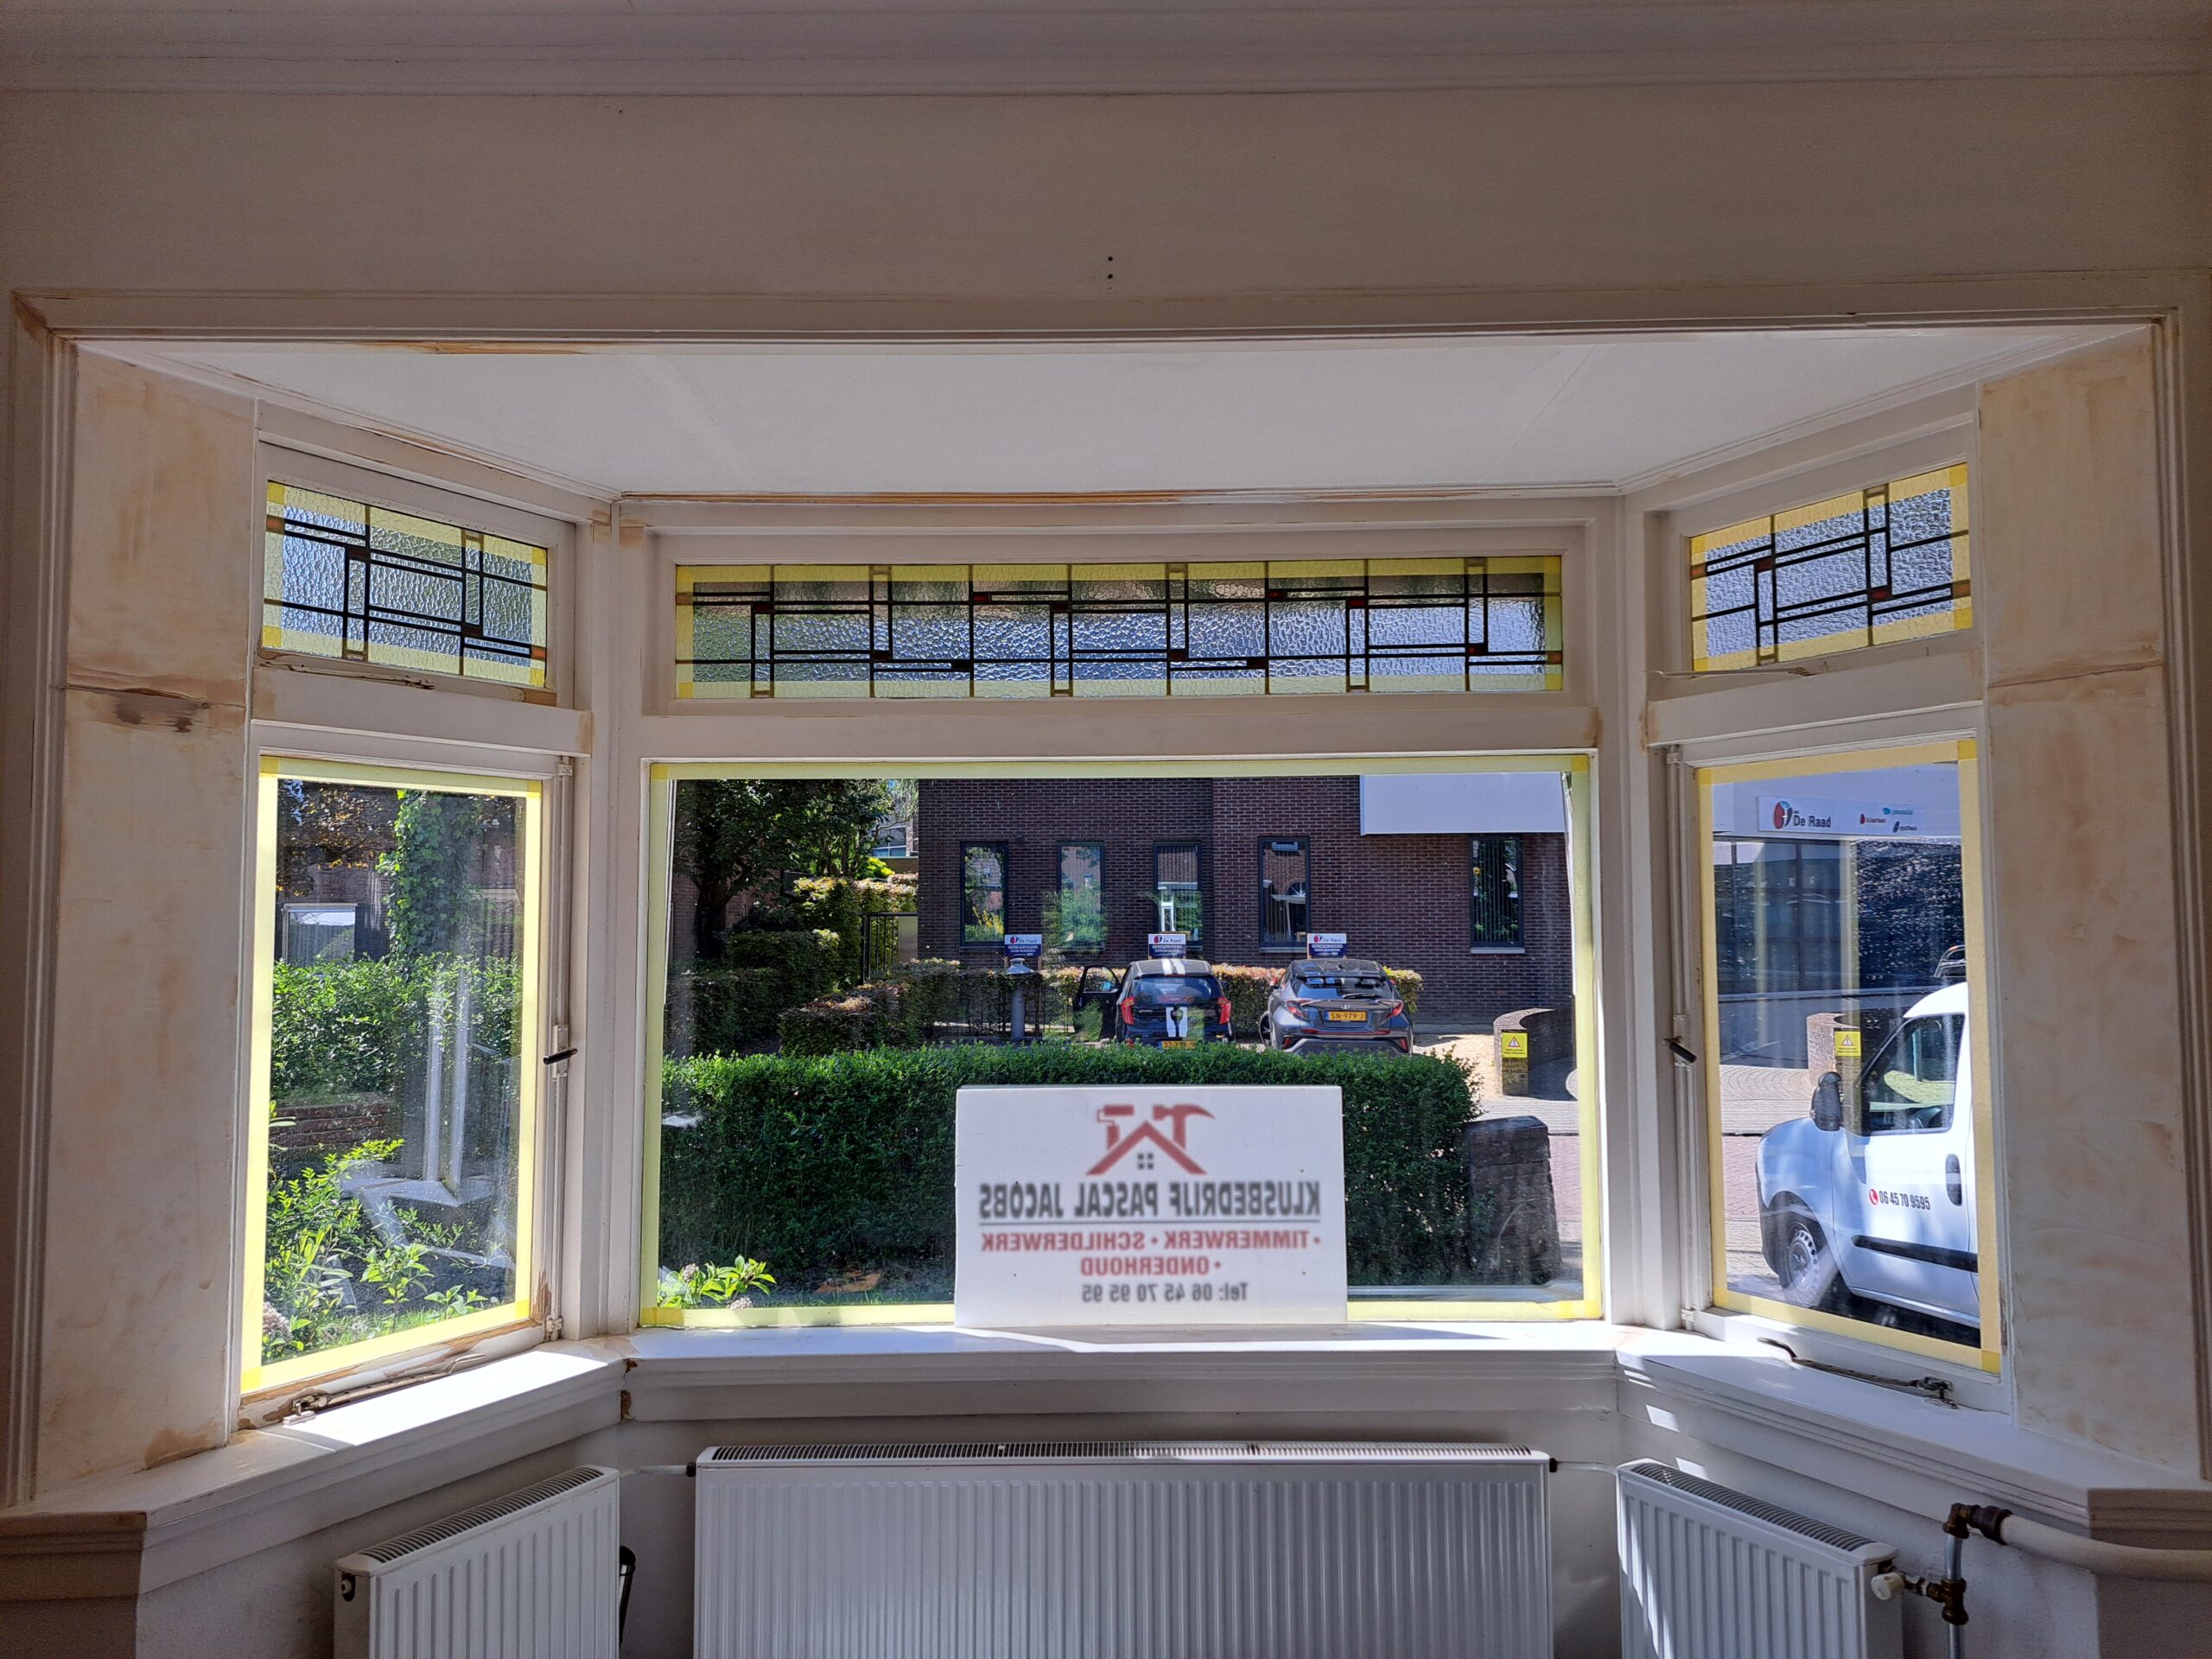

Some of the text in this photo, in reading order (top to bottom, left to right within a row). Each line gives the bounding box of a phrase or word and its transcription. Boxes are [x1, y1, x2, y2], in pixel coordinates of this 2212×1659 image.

[1793, 815, 1831, 828] De Raad
[1331, 1011, 1363, 1020] SN-979-J
[1878, 1190, 1930, 1211] 06 45 70 9595
